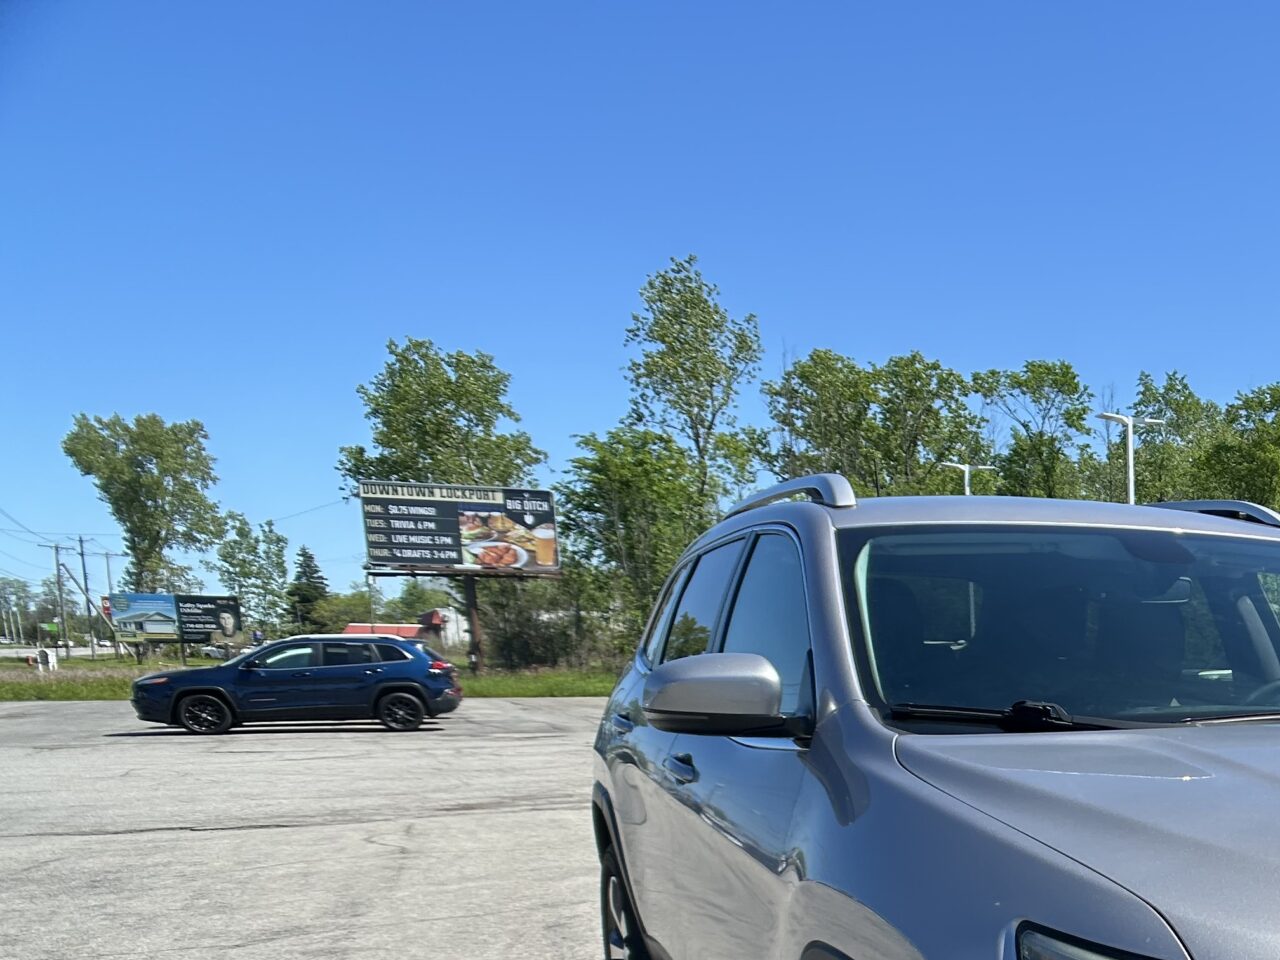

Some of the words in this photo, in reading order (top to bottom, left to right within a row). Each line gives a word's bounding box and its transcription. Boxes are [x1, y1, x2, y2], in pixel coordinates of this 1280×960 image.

[363, 484, 434, 497] DOWNTOWN
[440, 487, 496, 500] LOCKPORT
[506, 499, 521, 510] BIG
[523, 500, 549, 511] DITCH
